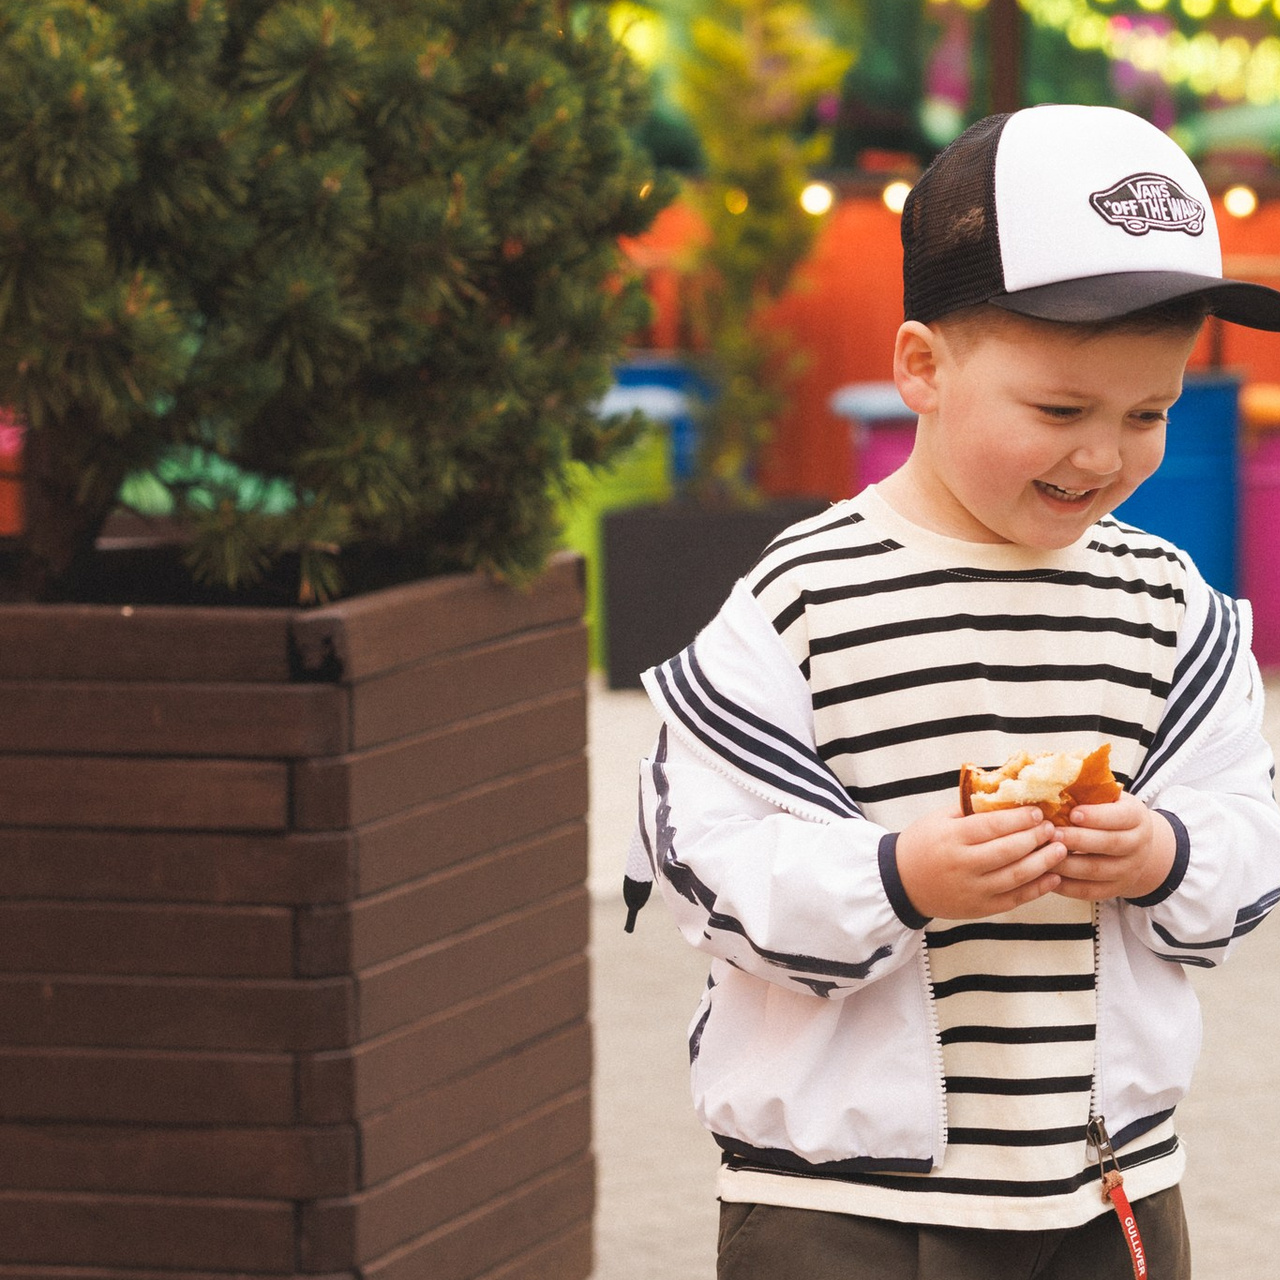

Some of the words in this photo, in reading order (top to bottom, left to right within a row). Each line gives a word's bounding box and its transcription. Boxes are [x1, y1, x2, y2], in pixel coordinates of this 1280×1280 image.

[1127, 181, 1171, 200] VANS
[1138, 197, 1171, 221] THE
[1125, 1217, 1146, 1276] GULLIVER
